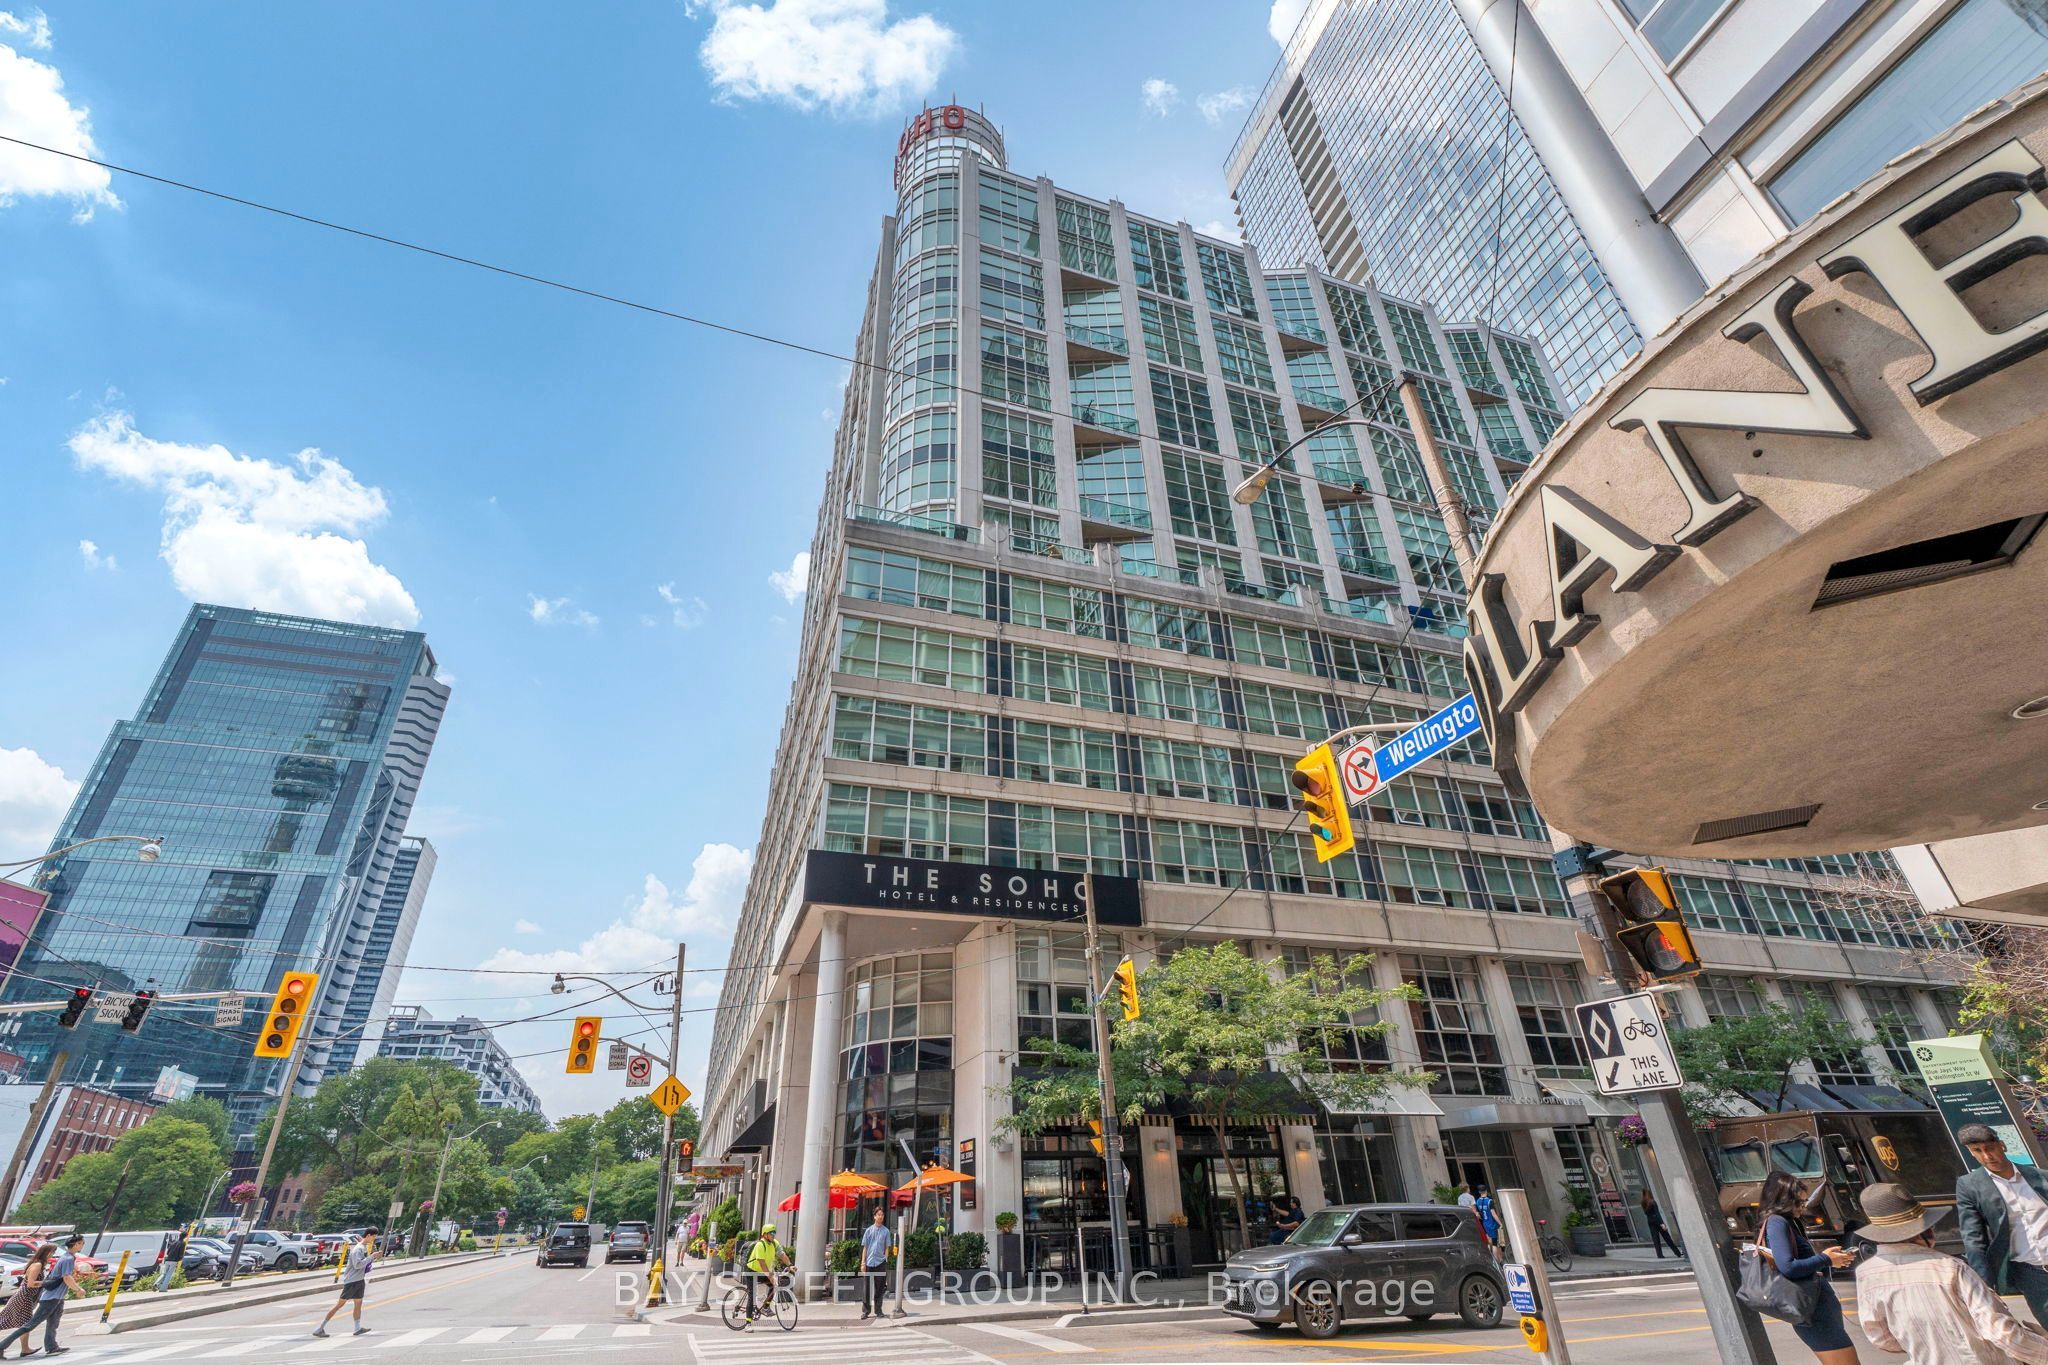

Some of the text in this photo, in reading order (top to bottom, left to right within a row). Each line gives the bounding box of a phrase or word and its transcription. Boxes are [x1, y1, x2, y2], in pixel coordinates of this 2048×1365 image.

[1387, 704, 1475, 766] Wellingto
[864, 863, 1088, 900] THE SOHO
[879, 889, 1079, 913] HOTEL & RESIDENCES
[104, 996, 133, 1006] BICYC
[216, 1016, 240, 1024] SIGNAL
[1630, 1055, 1659, 1070] THIS
[1633, 1071, 1668, 1086] LANE
[1877, 1146, 1896, 1165] ups
